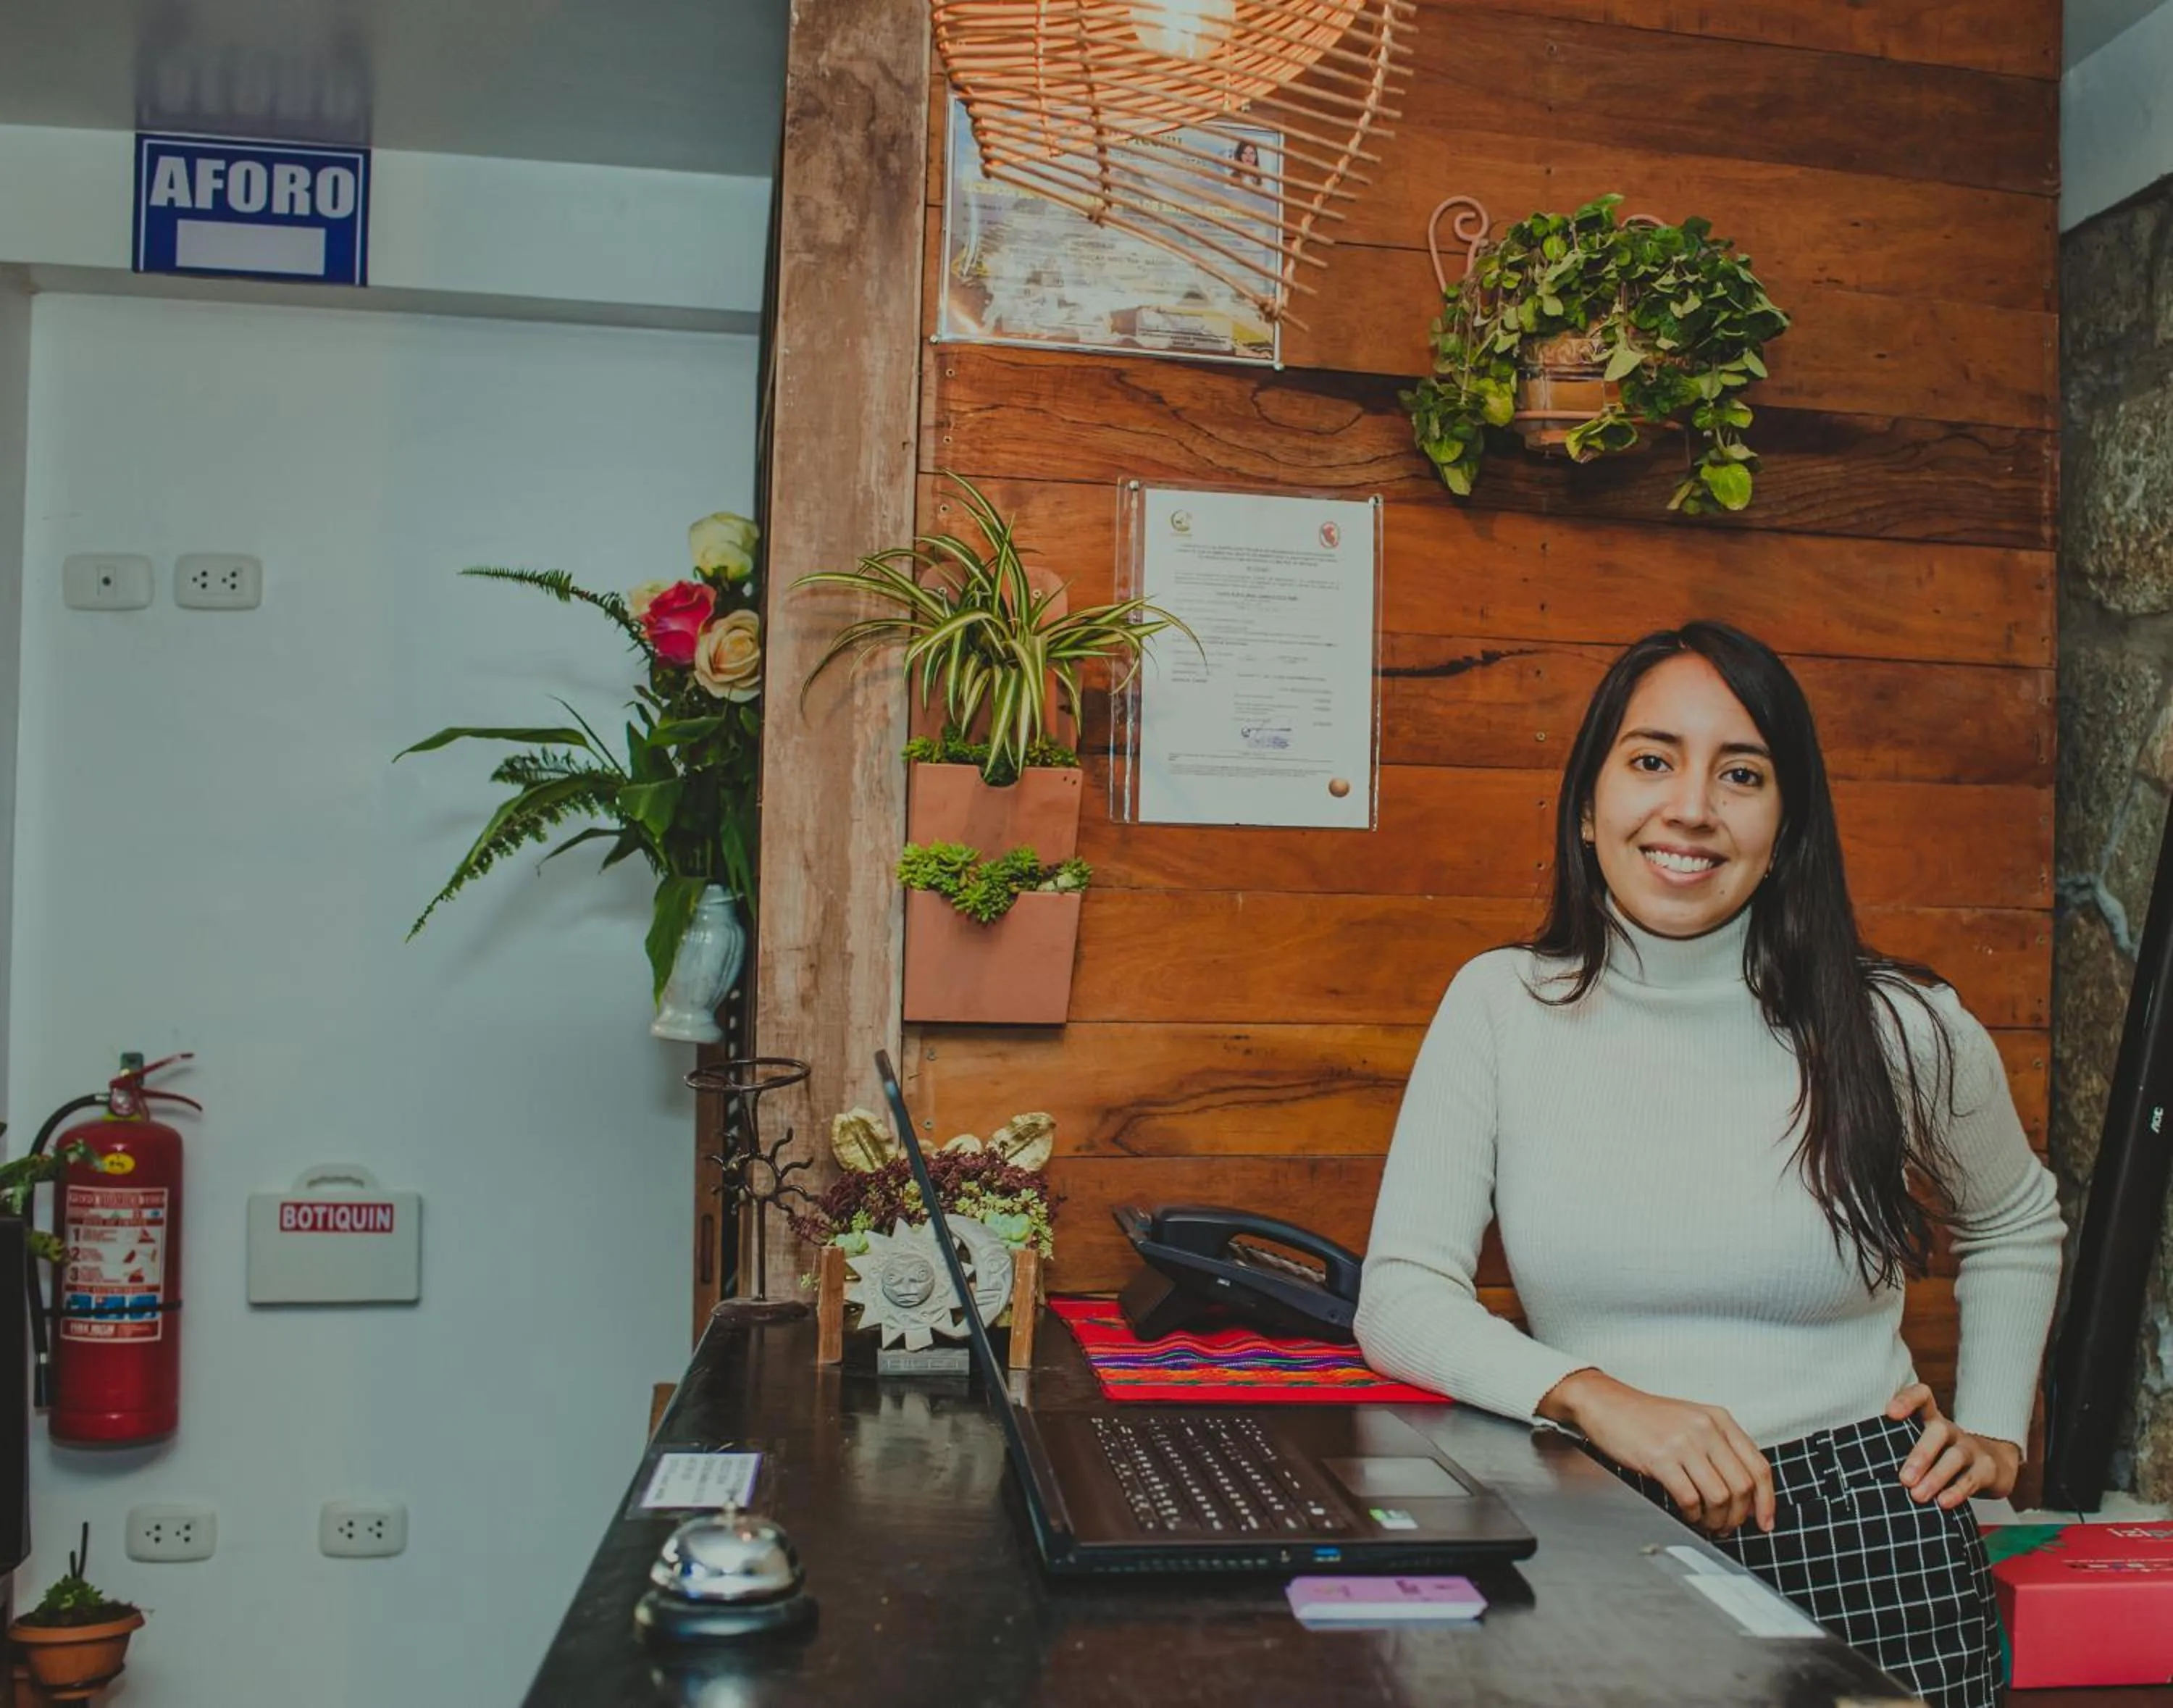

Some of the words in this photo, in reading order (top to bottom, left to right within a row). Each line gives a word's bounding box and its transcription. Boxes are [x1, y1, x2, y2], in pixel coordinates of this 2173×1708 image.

[149, 155, 355, 218] AFORO
[282, 1205, 393, 1231] BOTIQUIN
[73, 1228, 80, 1242] 1
[70, 1247, 80, 1262] 2
[69, 1266, 79, 1281] 3
